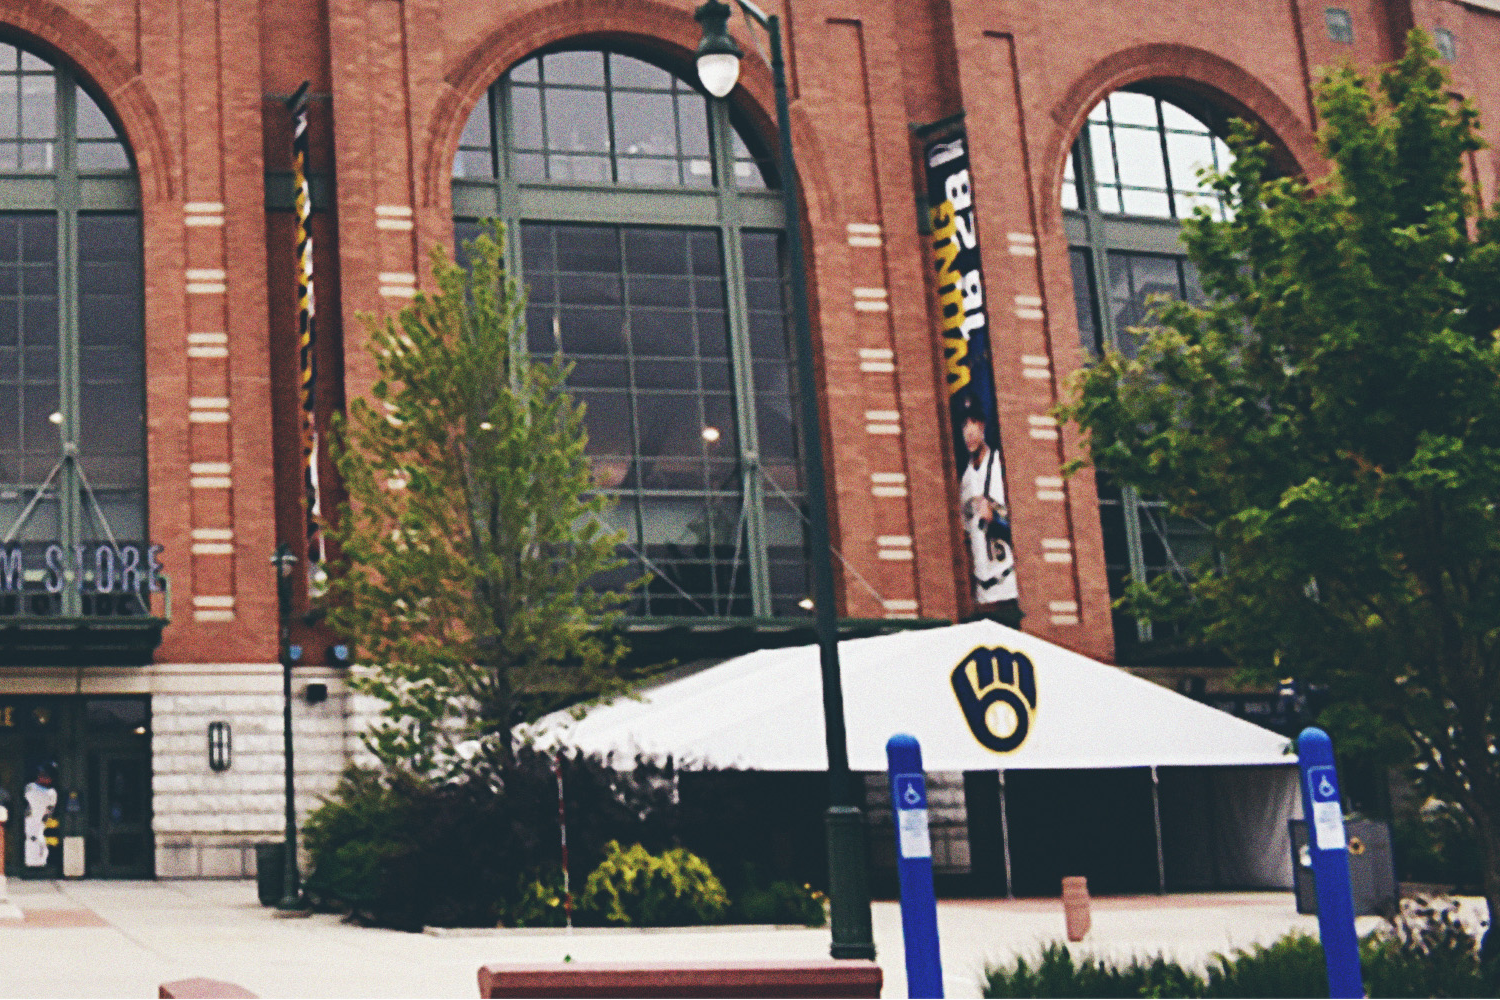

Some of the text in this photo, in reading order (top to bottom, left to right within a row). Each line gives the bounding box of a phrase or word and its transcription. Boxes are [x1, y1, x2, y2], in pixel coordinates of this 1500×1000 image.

[929, 199, 971, 390] WONG
[945, 168, 985, 341] 16 2B
[45, 543, 164, 593] STORE
